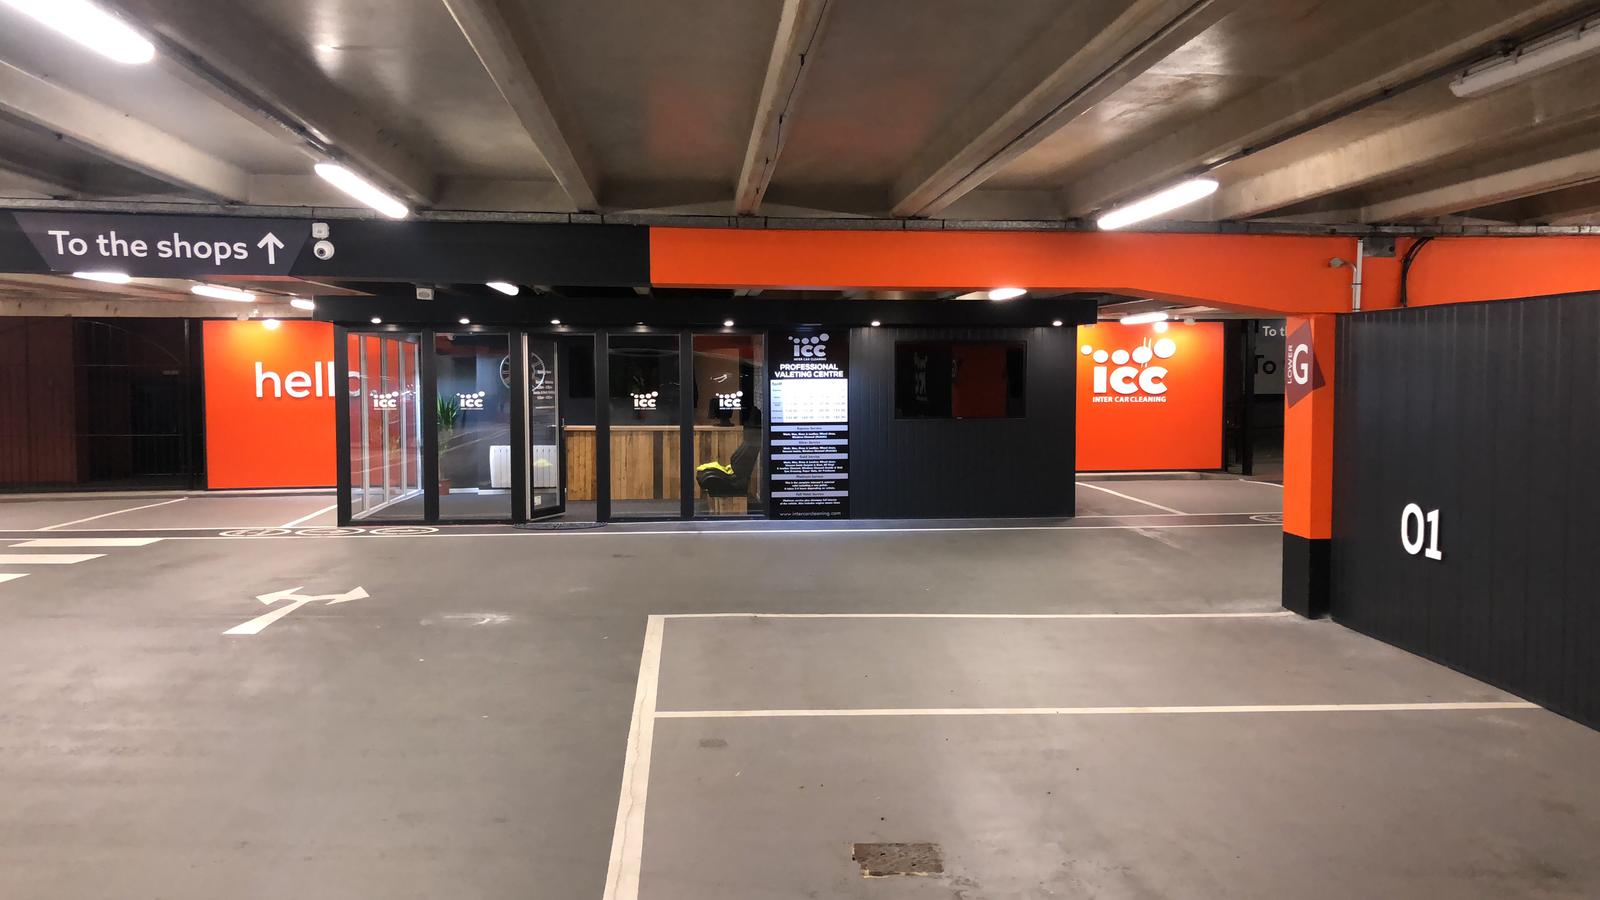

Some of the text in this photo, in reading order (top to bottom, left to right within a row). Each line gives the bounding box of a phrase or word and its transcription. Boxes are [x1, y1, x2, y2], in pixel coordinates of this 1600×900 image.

[48, 230, 249, 265] To the shops
[1262, 326, 1277, 337] To
[793, 338, 826, 357] icc
[1093, 350, 1168, 394] icc
[1293, 343, 1309, 385] G
[373, 394, 397, 408] icc
[460, 394, 484, 408] icc
[634, 394, 657, 408] icc
[719, 394, 742, 408] icc
[1401, 503, 1442, 560] 01
